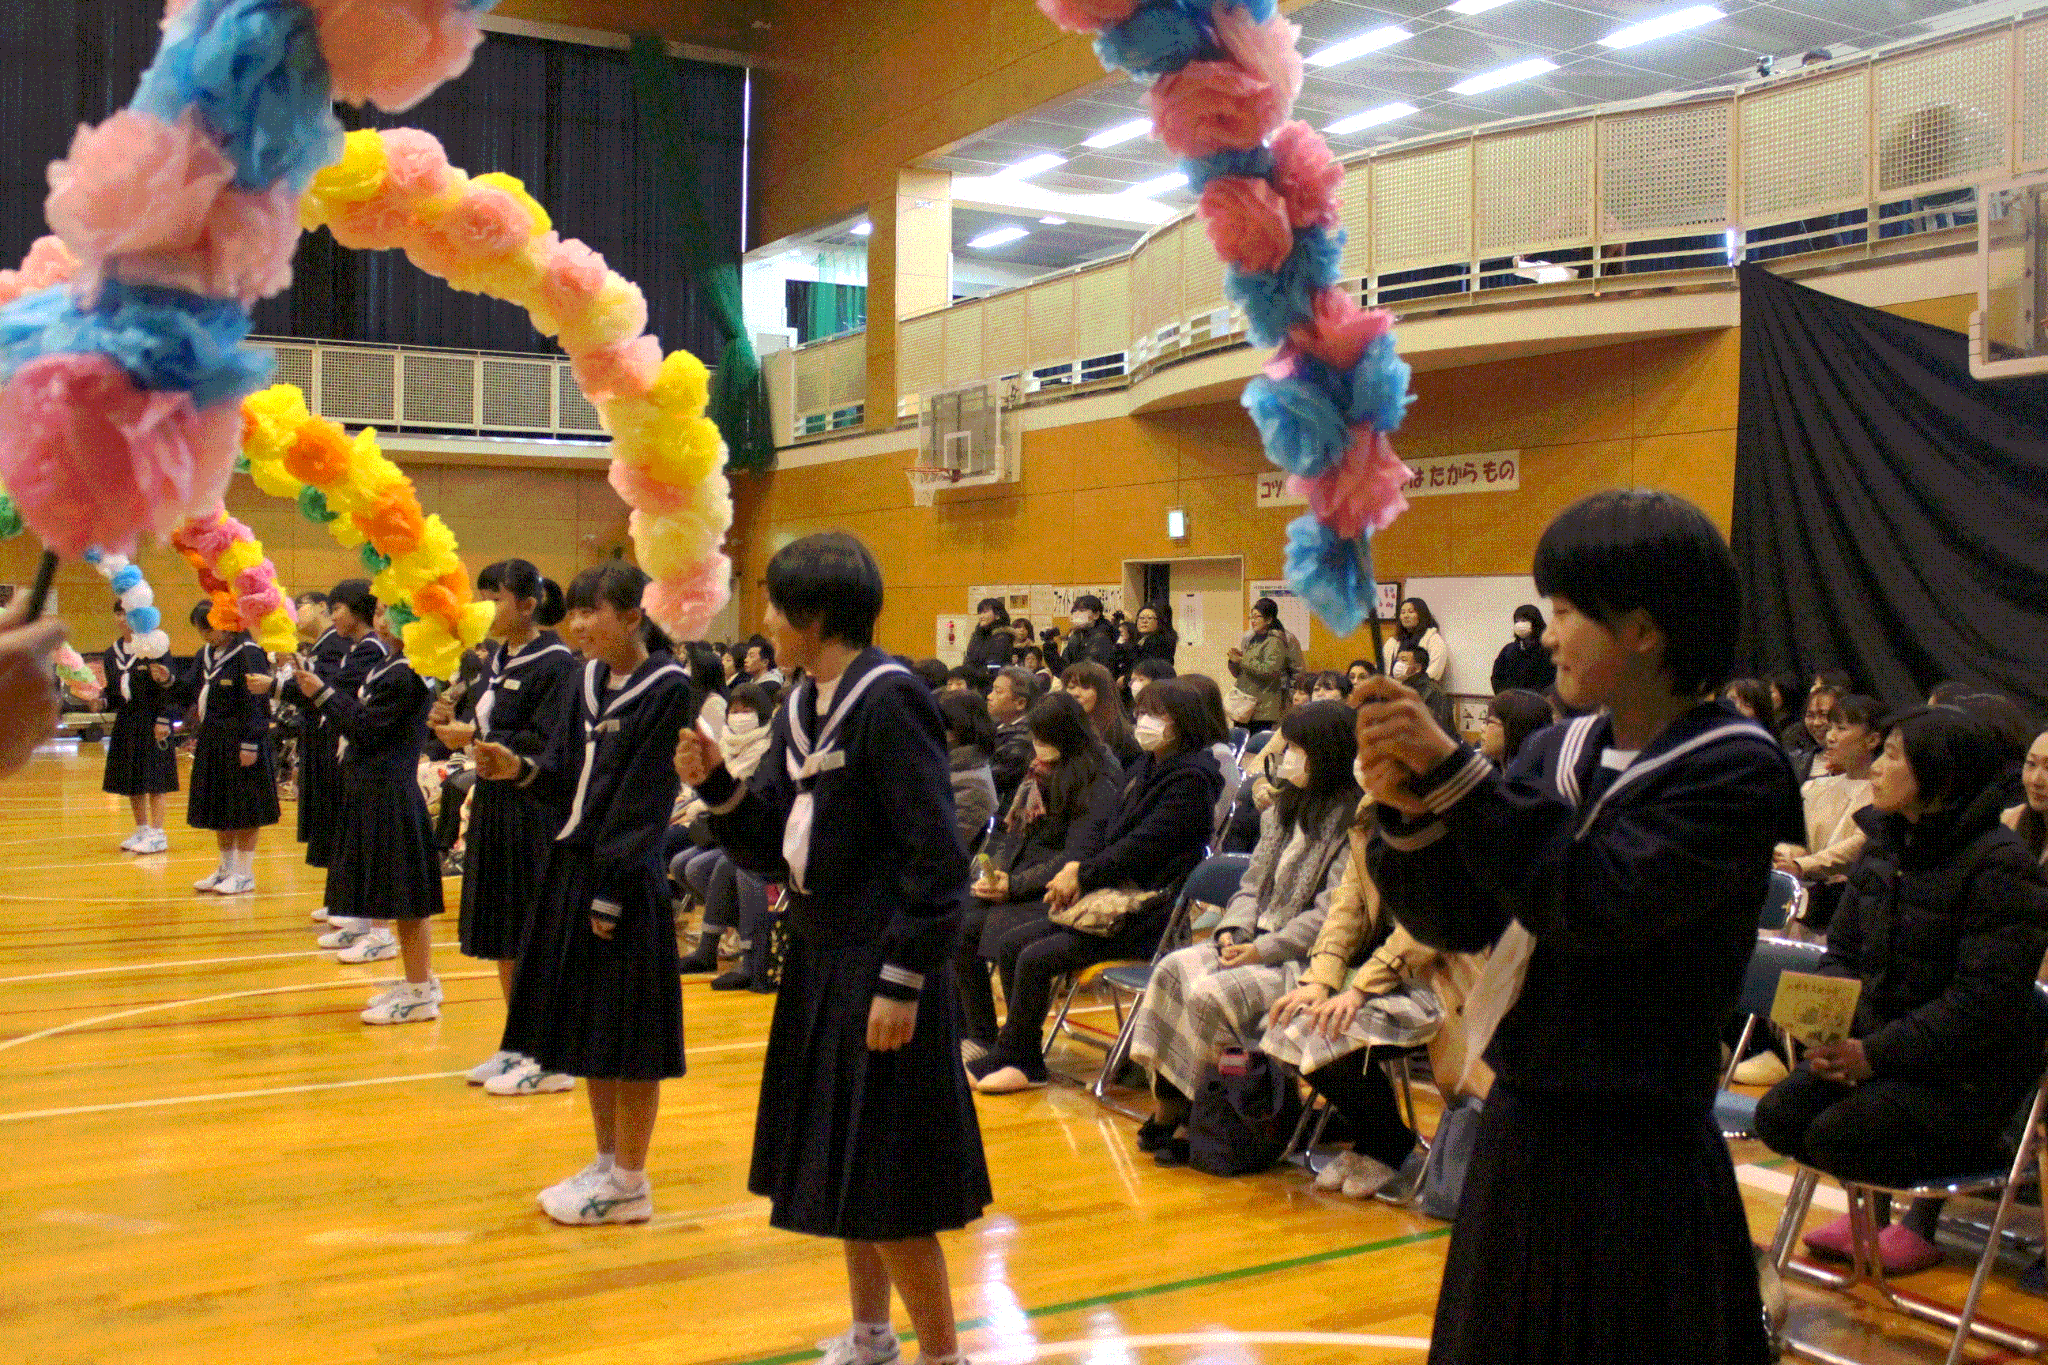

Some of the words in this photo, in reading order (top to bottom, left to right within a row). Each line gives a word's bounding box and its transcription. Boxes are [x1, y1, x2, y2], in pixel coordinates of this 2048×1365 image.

[1400, 460, 1515, 491] はたからもの
